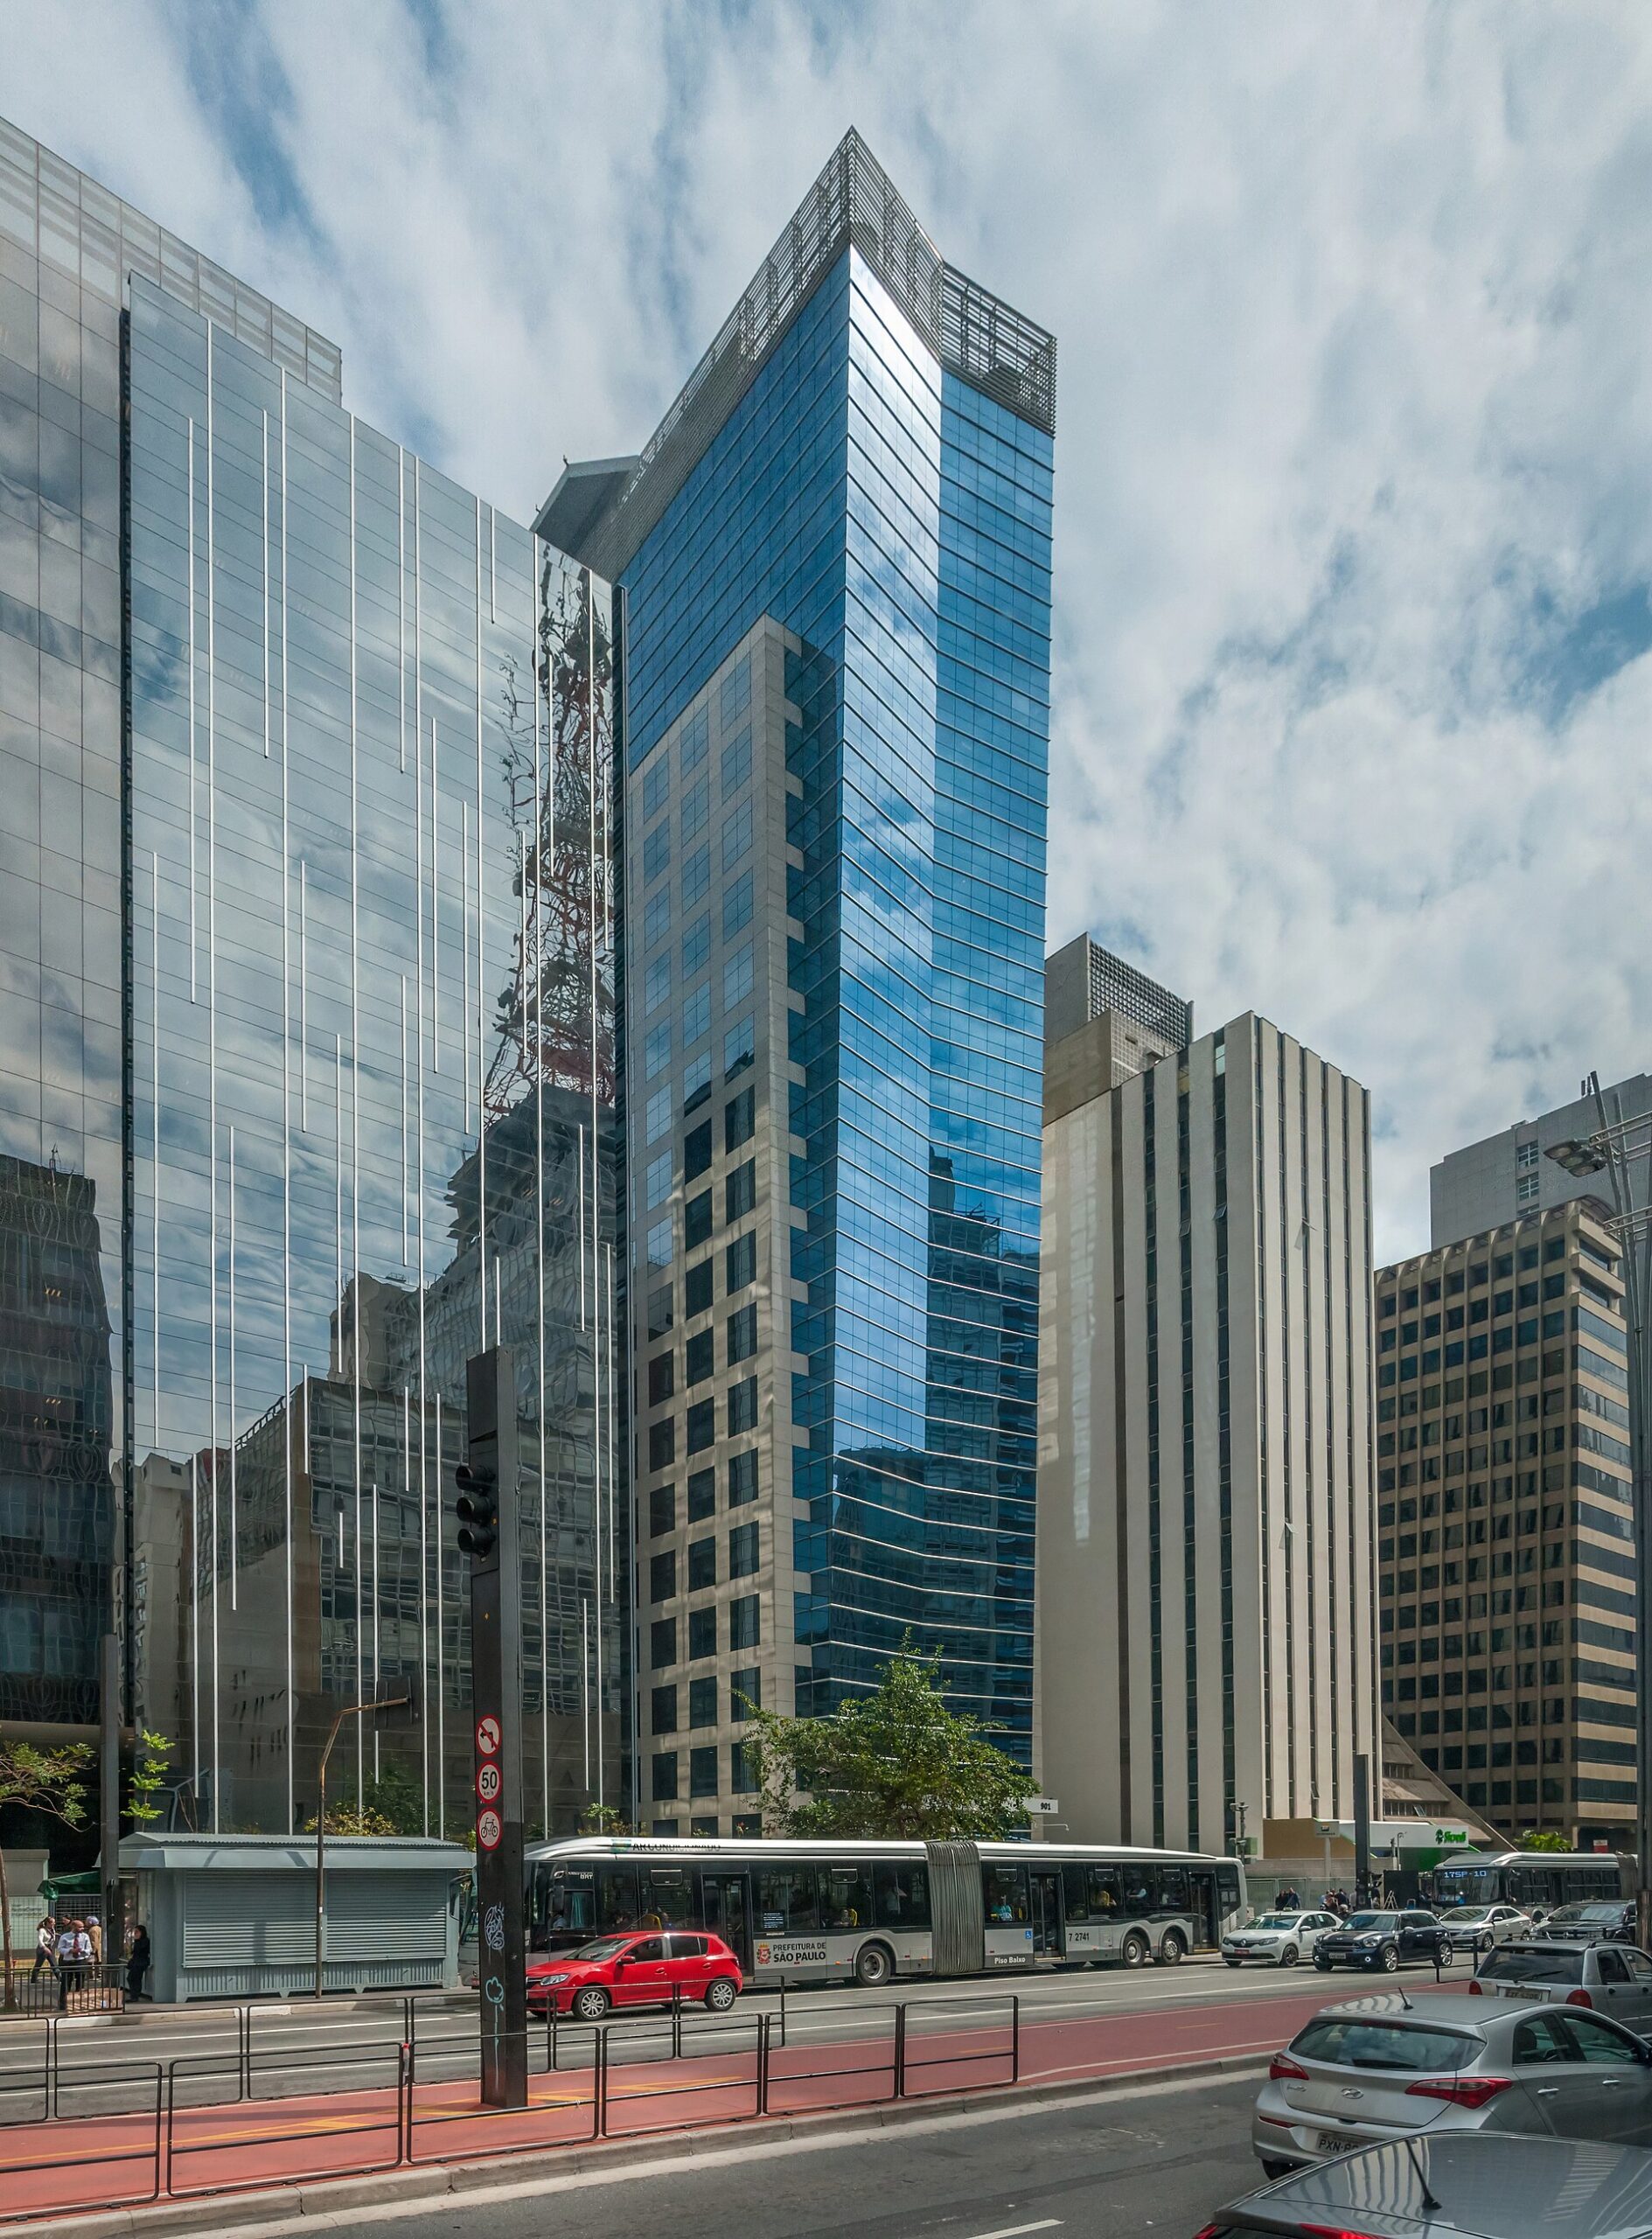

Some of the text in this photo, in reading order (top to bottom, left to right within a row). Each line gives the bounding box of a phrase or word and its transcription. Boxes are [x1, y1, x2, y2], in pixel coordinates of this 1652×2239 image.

[482, 1771, 497, 1789] 50
[1069, 1932, 1090, 1942] 7 2741
[773, 1943, 815, 1951] PREFEITURA
[773, 1950, 826, 1963] SÃO PAULO
[1008, 1956, 1026, 1964] Baixo
